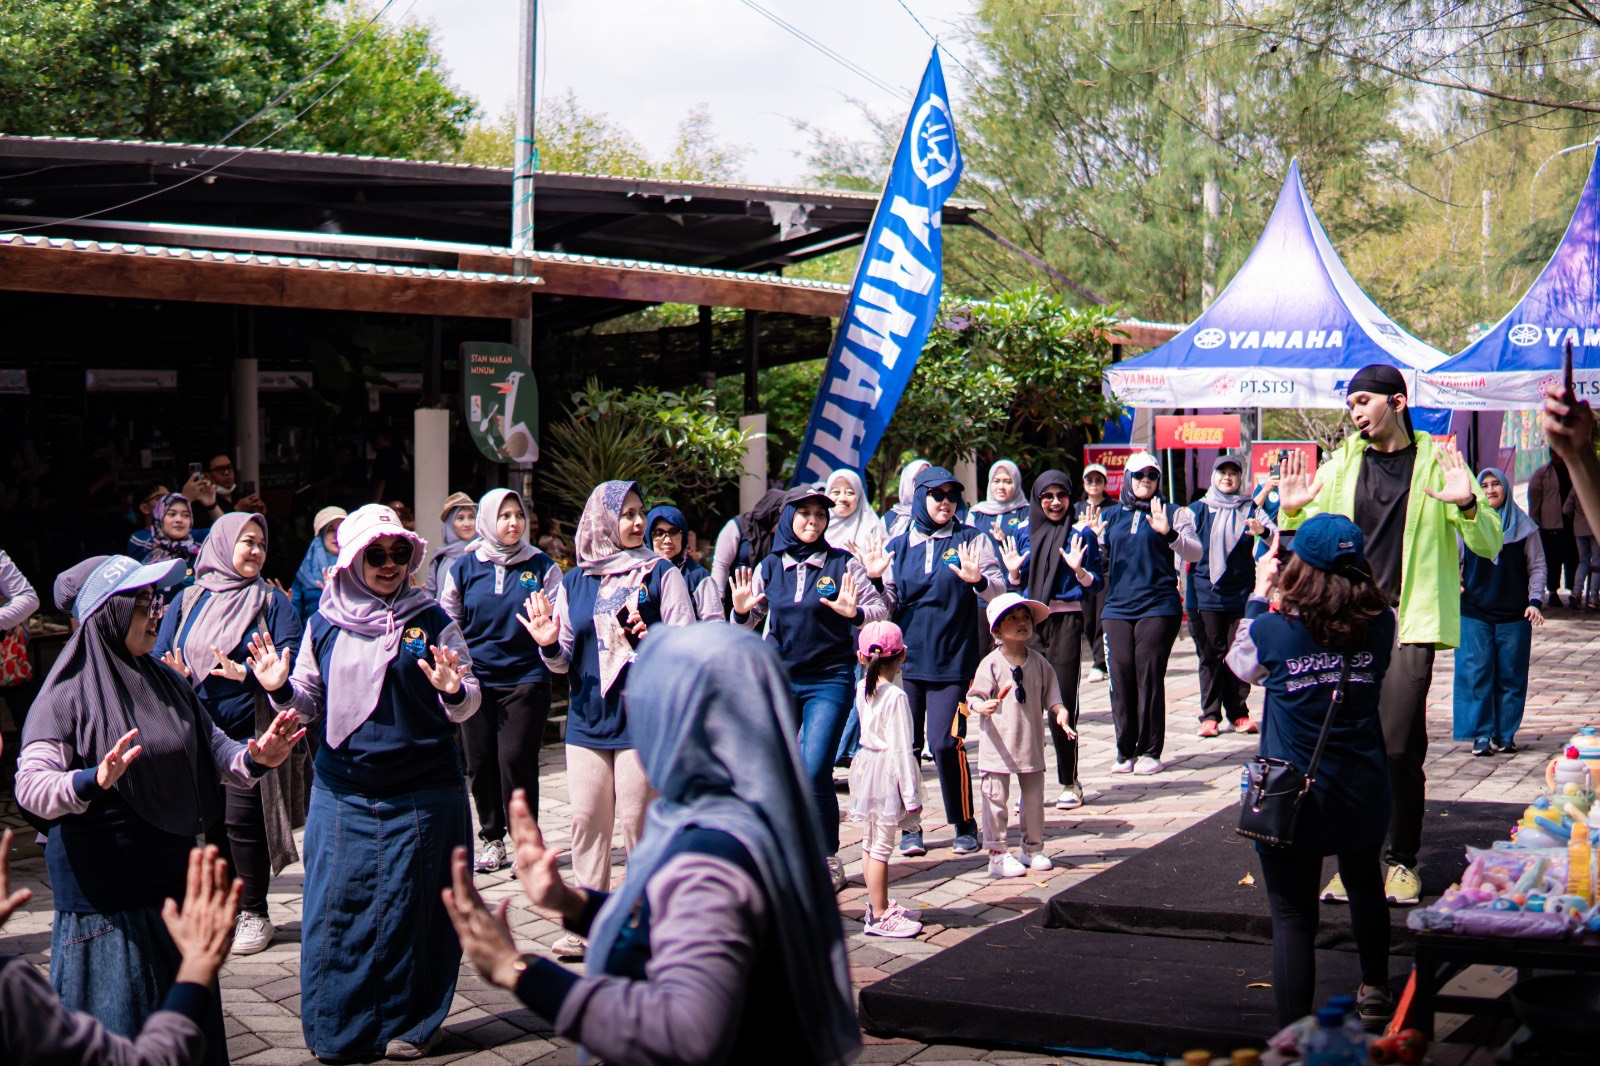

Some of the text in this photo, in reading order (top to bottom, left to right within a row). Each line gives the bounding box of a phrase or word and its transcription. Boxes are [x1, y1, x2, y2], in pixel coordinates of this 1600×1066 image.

[1228, 330, 1343, 349] YAMAHA
[471, 354, 513, 364] STAN MAKAN
[471, 366, 495, 375] MINUM
[1123, 374, 1166, 385] YAMAHA
[1240, 380, 1295, 393] PT.STSJ
[1182, 427, 1224, 441] FIESTA
[1102, 455, 1129, 466] FIEST
[1318, 671, 1375, 683] SURBAYA
